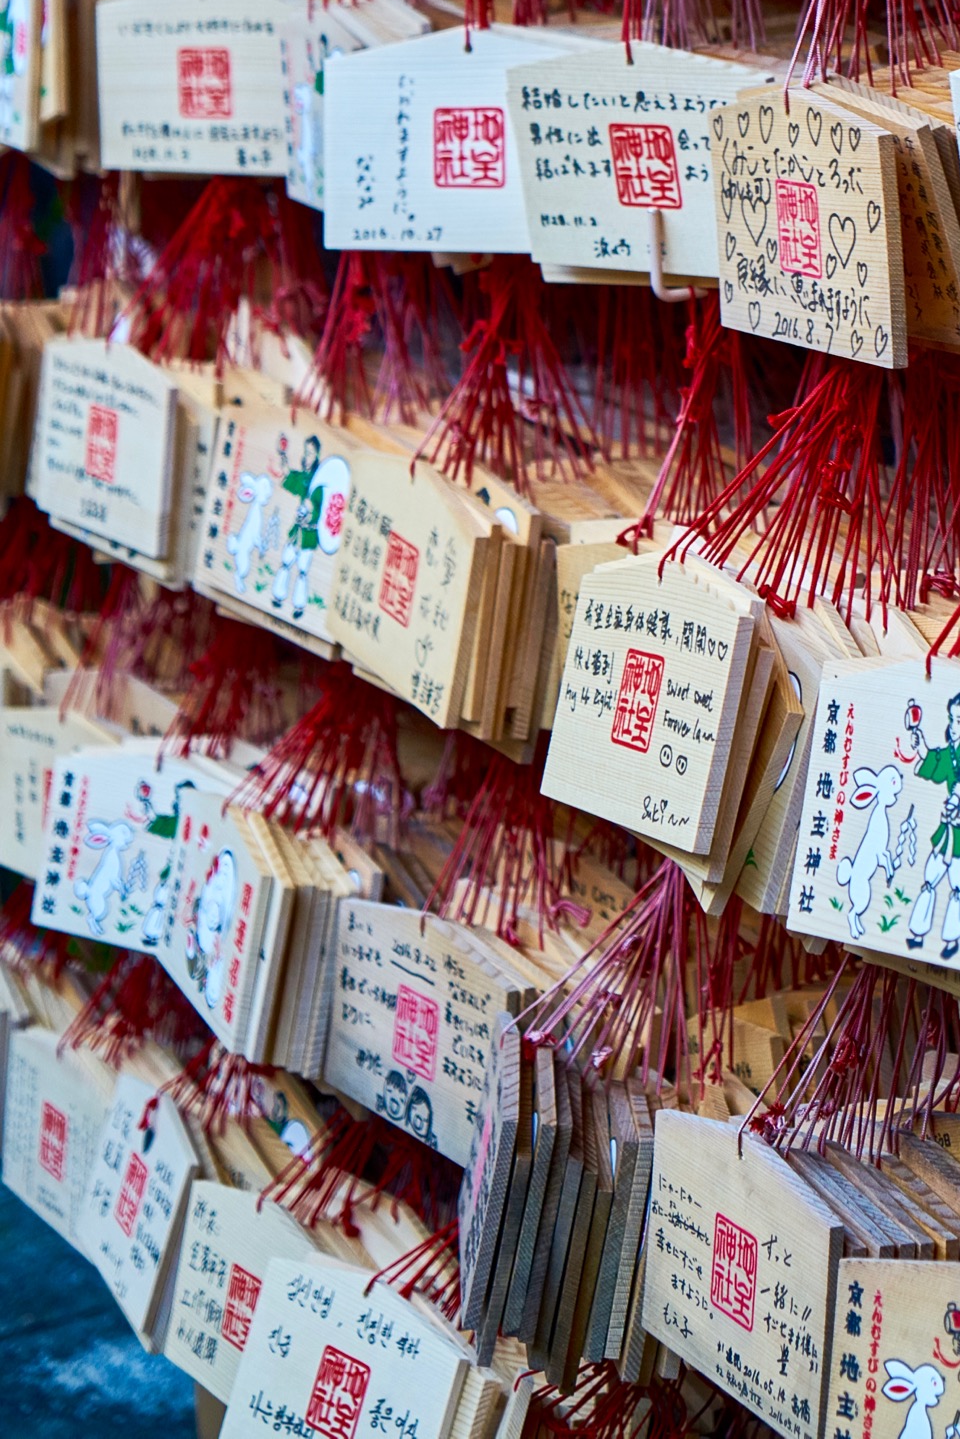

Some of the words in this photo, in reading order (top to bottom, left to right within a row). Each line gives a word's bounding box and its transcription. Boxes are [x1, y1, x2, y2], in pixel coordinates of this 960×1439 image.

[822, 697, 841, 755] 京都
[797, 770, 834, 914] 地主神社
[843, 1279, 864, 1337] 京都
